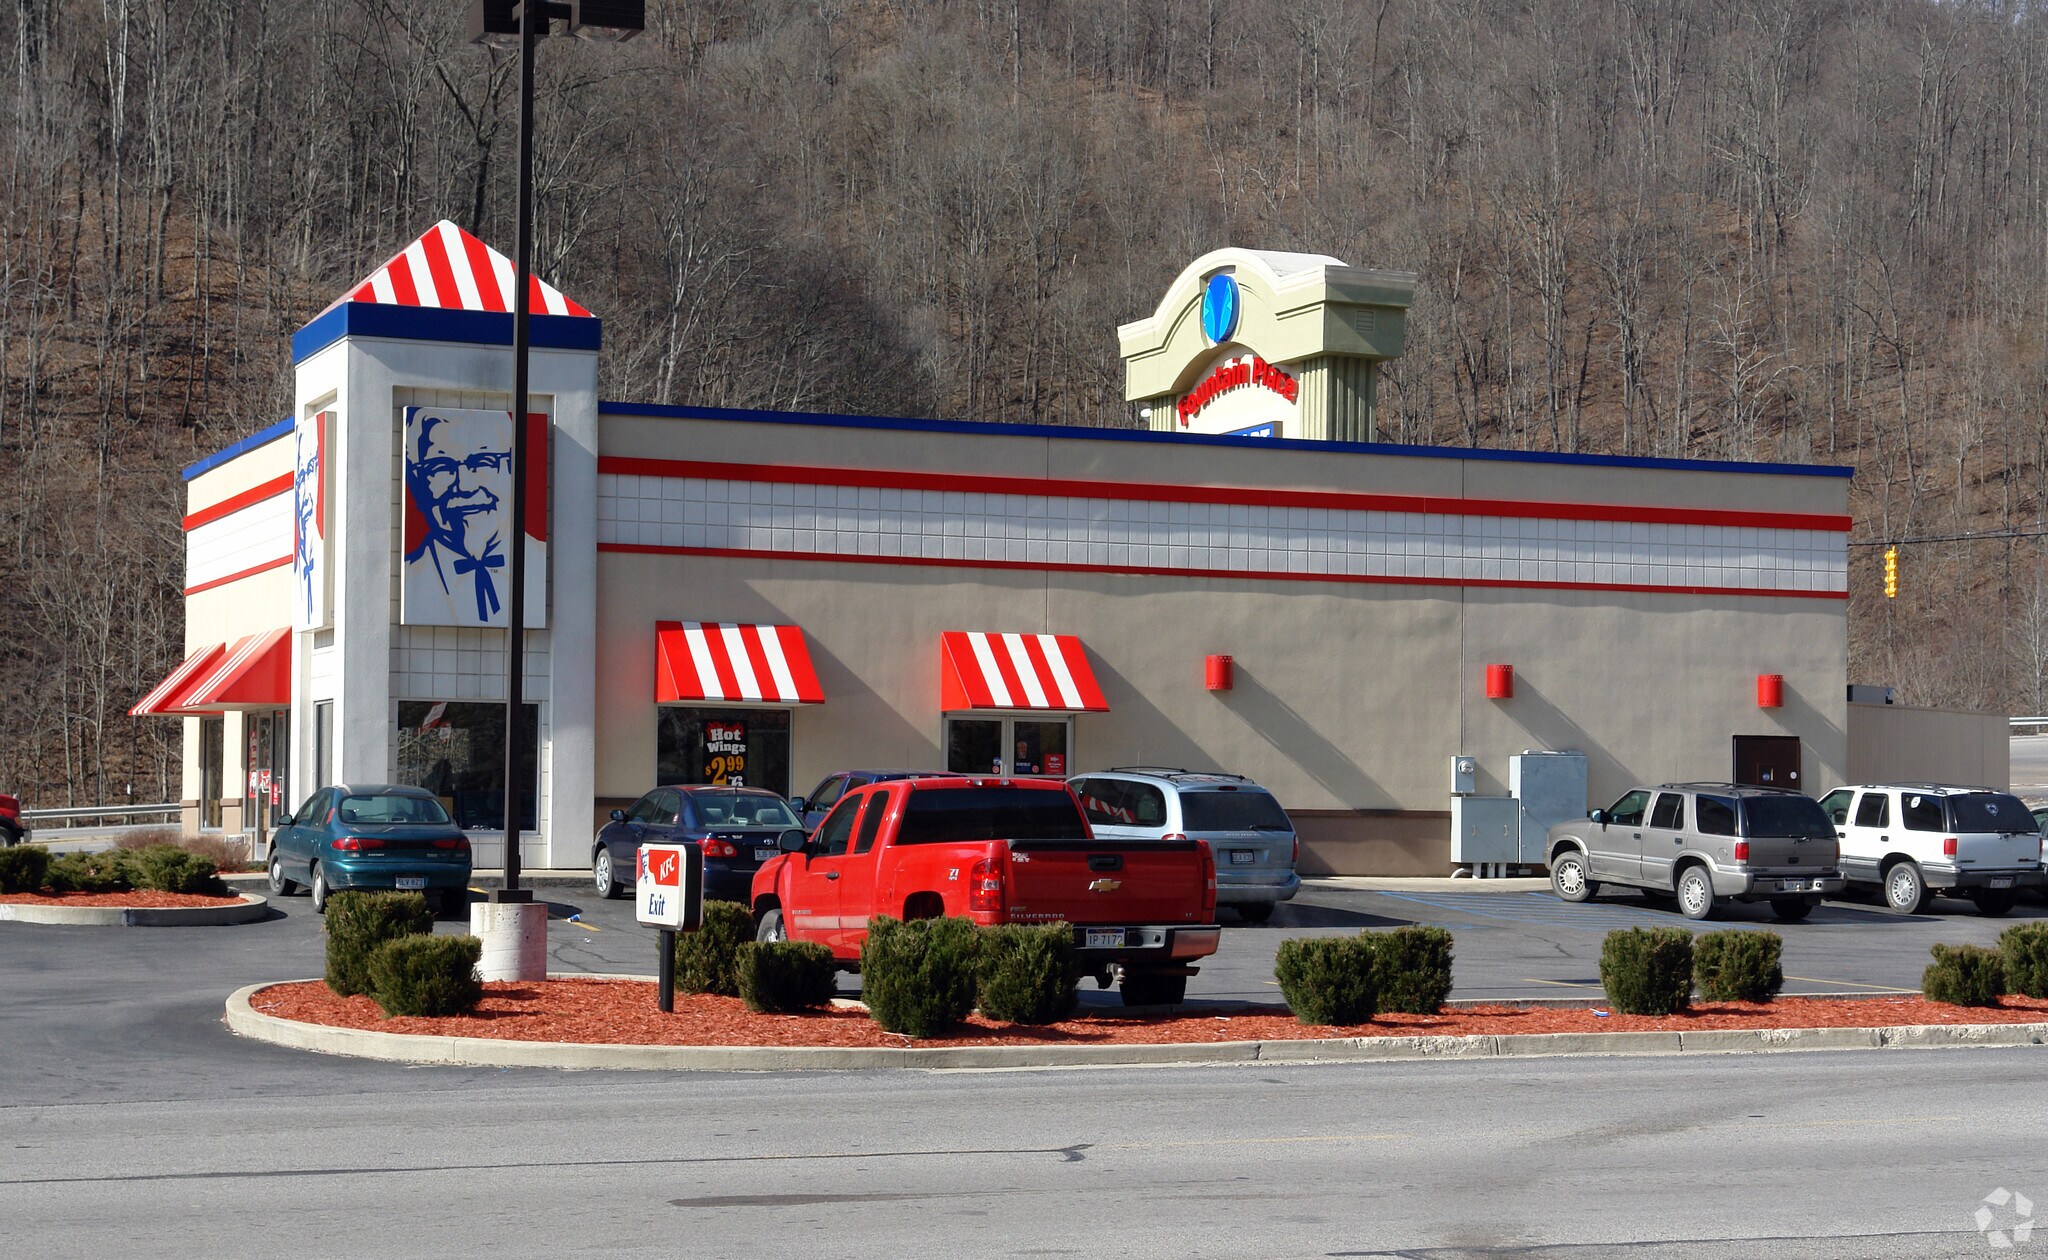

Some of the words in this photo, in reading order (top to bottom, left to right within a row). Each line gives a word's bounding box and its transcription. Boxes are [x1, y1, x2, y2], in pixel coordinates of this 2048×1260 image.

[1177, 357, 1251, 427] Fountain
[1252, 356, 1299, 405] Place
[710, 728, 741, 741] Hot
[707, 741, 746, 755] Wings
[659, 853, 675, 881] KFC
[648, 893, 665, 916] Exit
